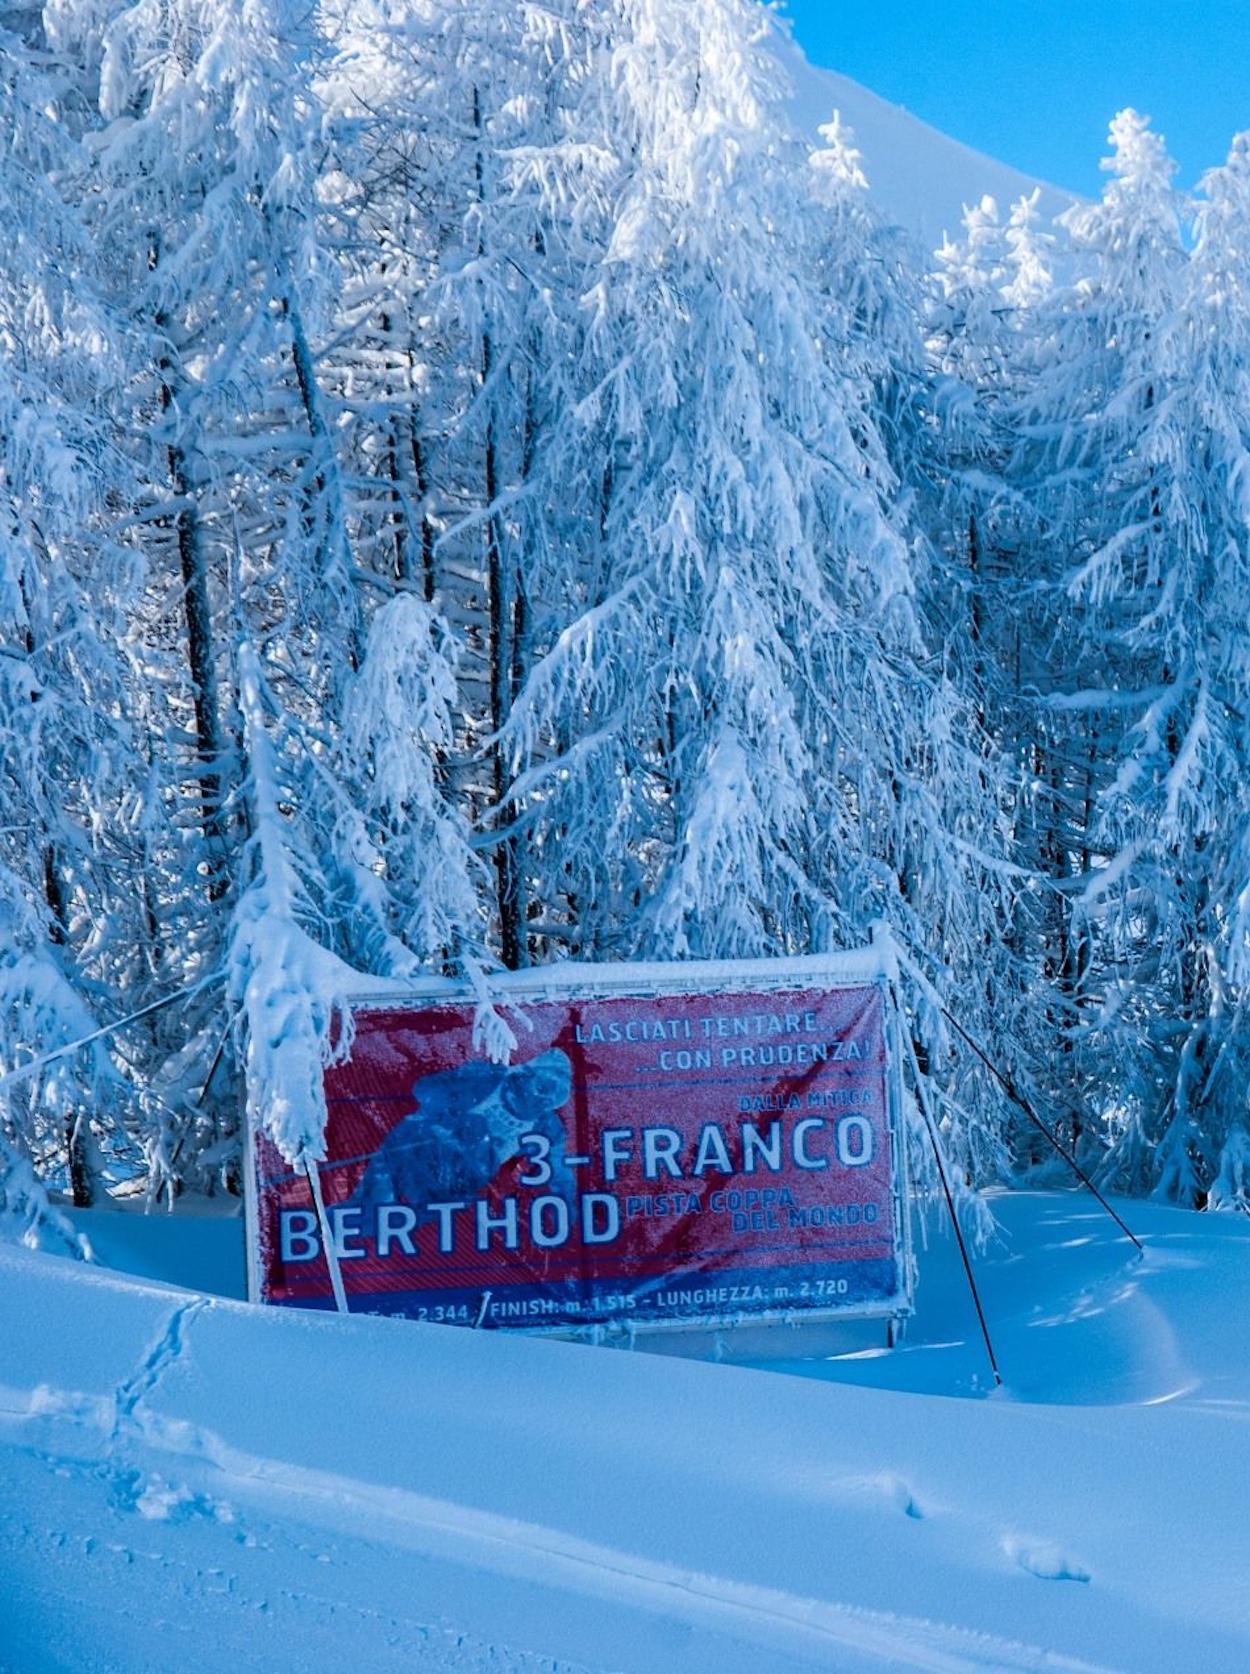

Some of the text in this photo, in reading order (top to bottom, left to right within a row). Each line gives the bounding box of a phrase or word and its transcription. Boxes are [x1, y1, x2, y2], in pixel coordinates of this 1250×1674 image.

[575, 1017, 691, 1044] LASCIATI
[722, 1040, 873, 1066] PRUDENZA!
[738, 1088, 872, 1113] DALLA MITICA
[625, 1187, 796, 1218] PISTA COPPA
[279, 1192, 620, 1263] BERTHOD
[731, 1203, 880, 1234] DEL MONDO
[418, 1304, 468, 1321] 2.344
[490, 1300, 560, 1317] FINISH:
[656, 1284, 770, 1307] LUNGHEZZA:
[774, 1284, 794, 1299] m.
[800, 1279, 849, 1298] 2.720
